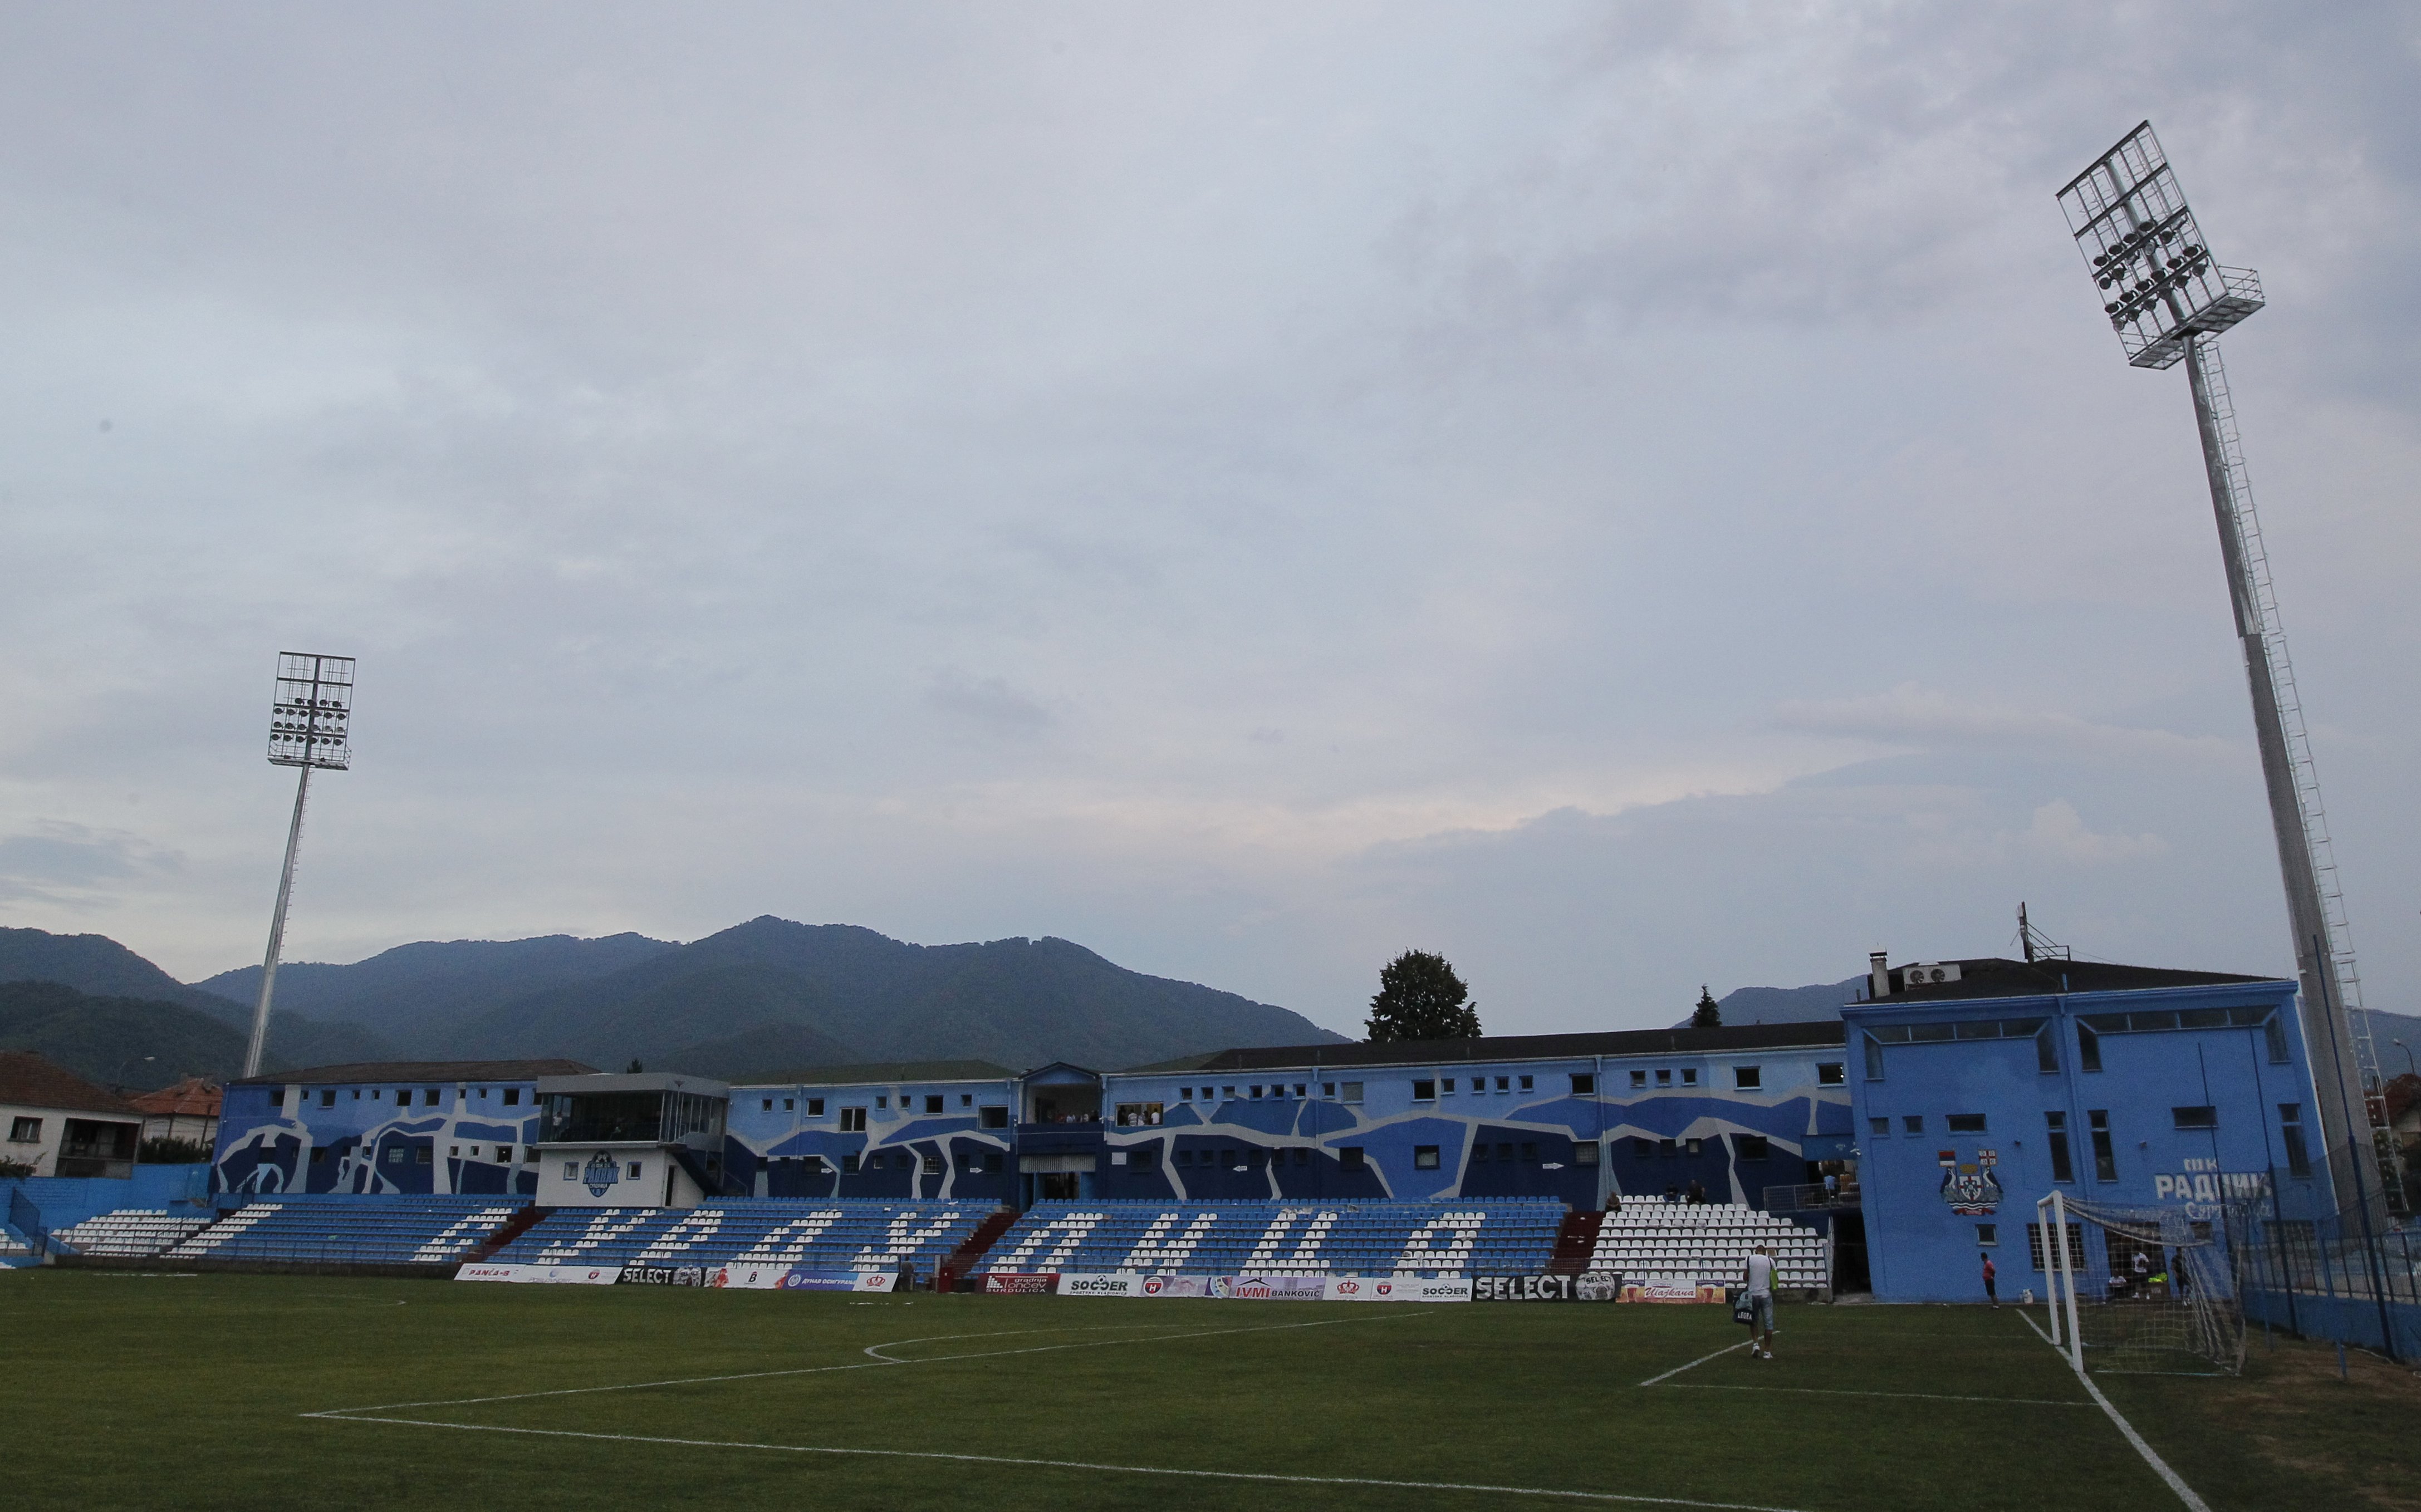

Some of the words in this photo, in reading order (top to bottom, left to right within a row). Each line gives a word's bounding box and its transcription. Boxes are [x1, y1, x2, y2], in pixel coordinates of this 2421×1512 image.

[623, 1268, 672, 1284] SELECT
[1071, 1281, 1128, 1291] SOCCER
[1236, 1287, 1271, 1298] IVMI
[1476, 1275, 1571, 1300] SELECT
